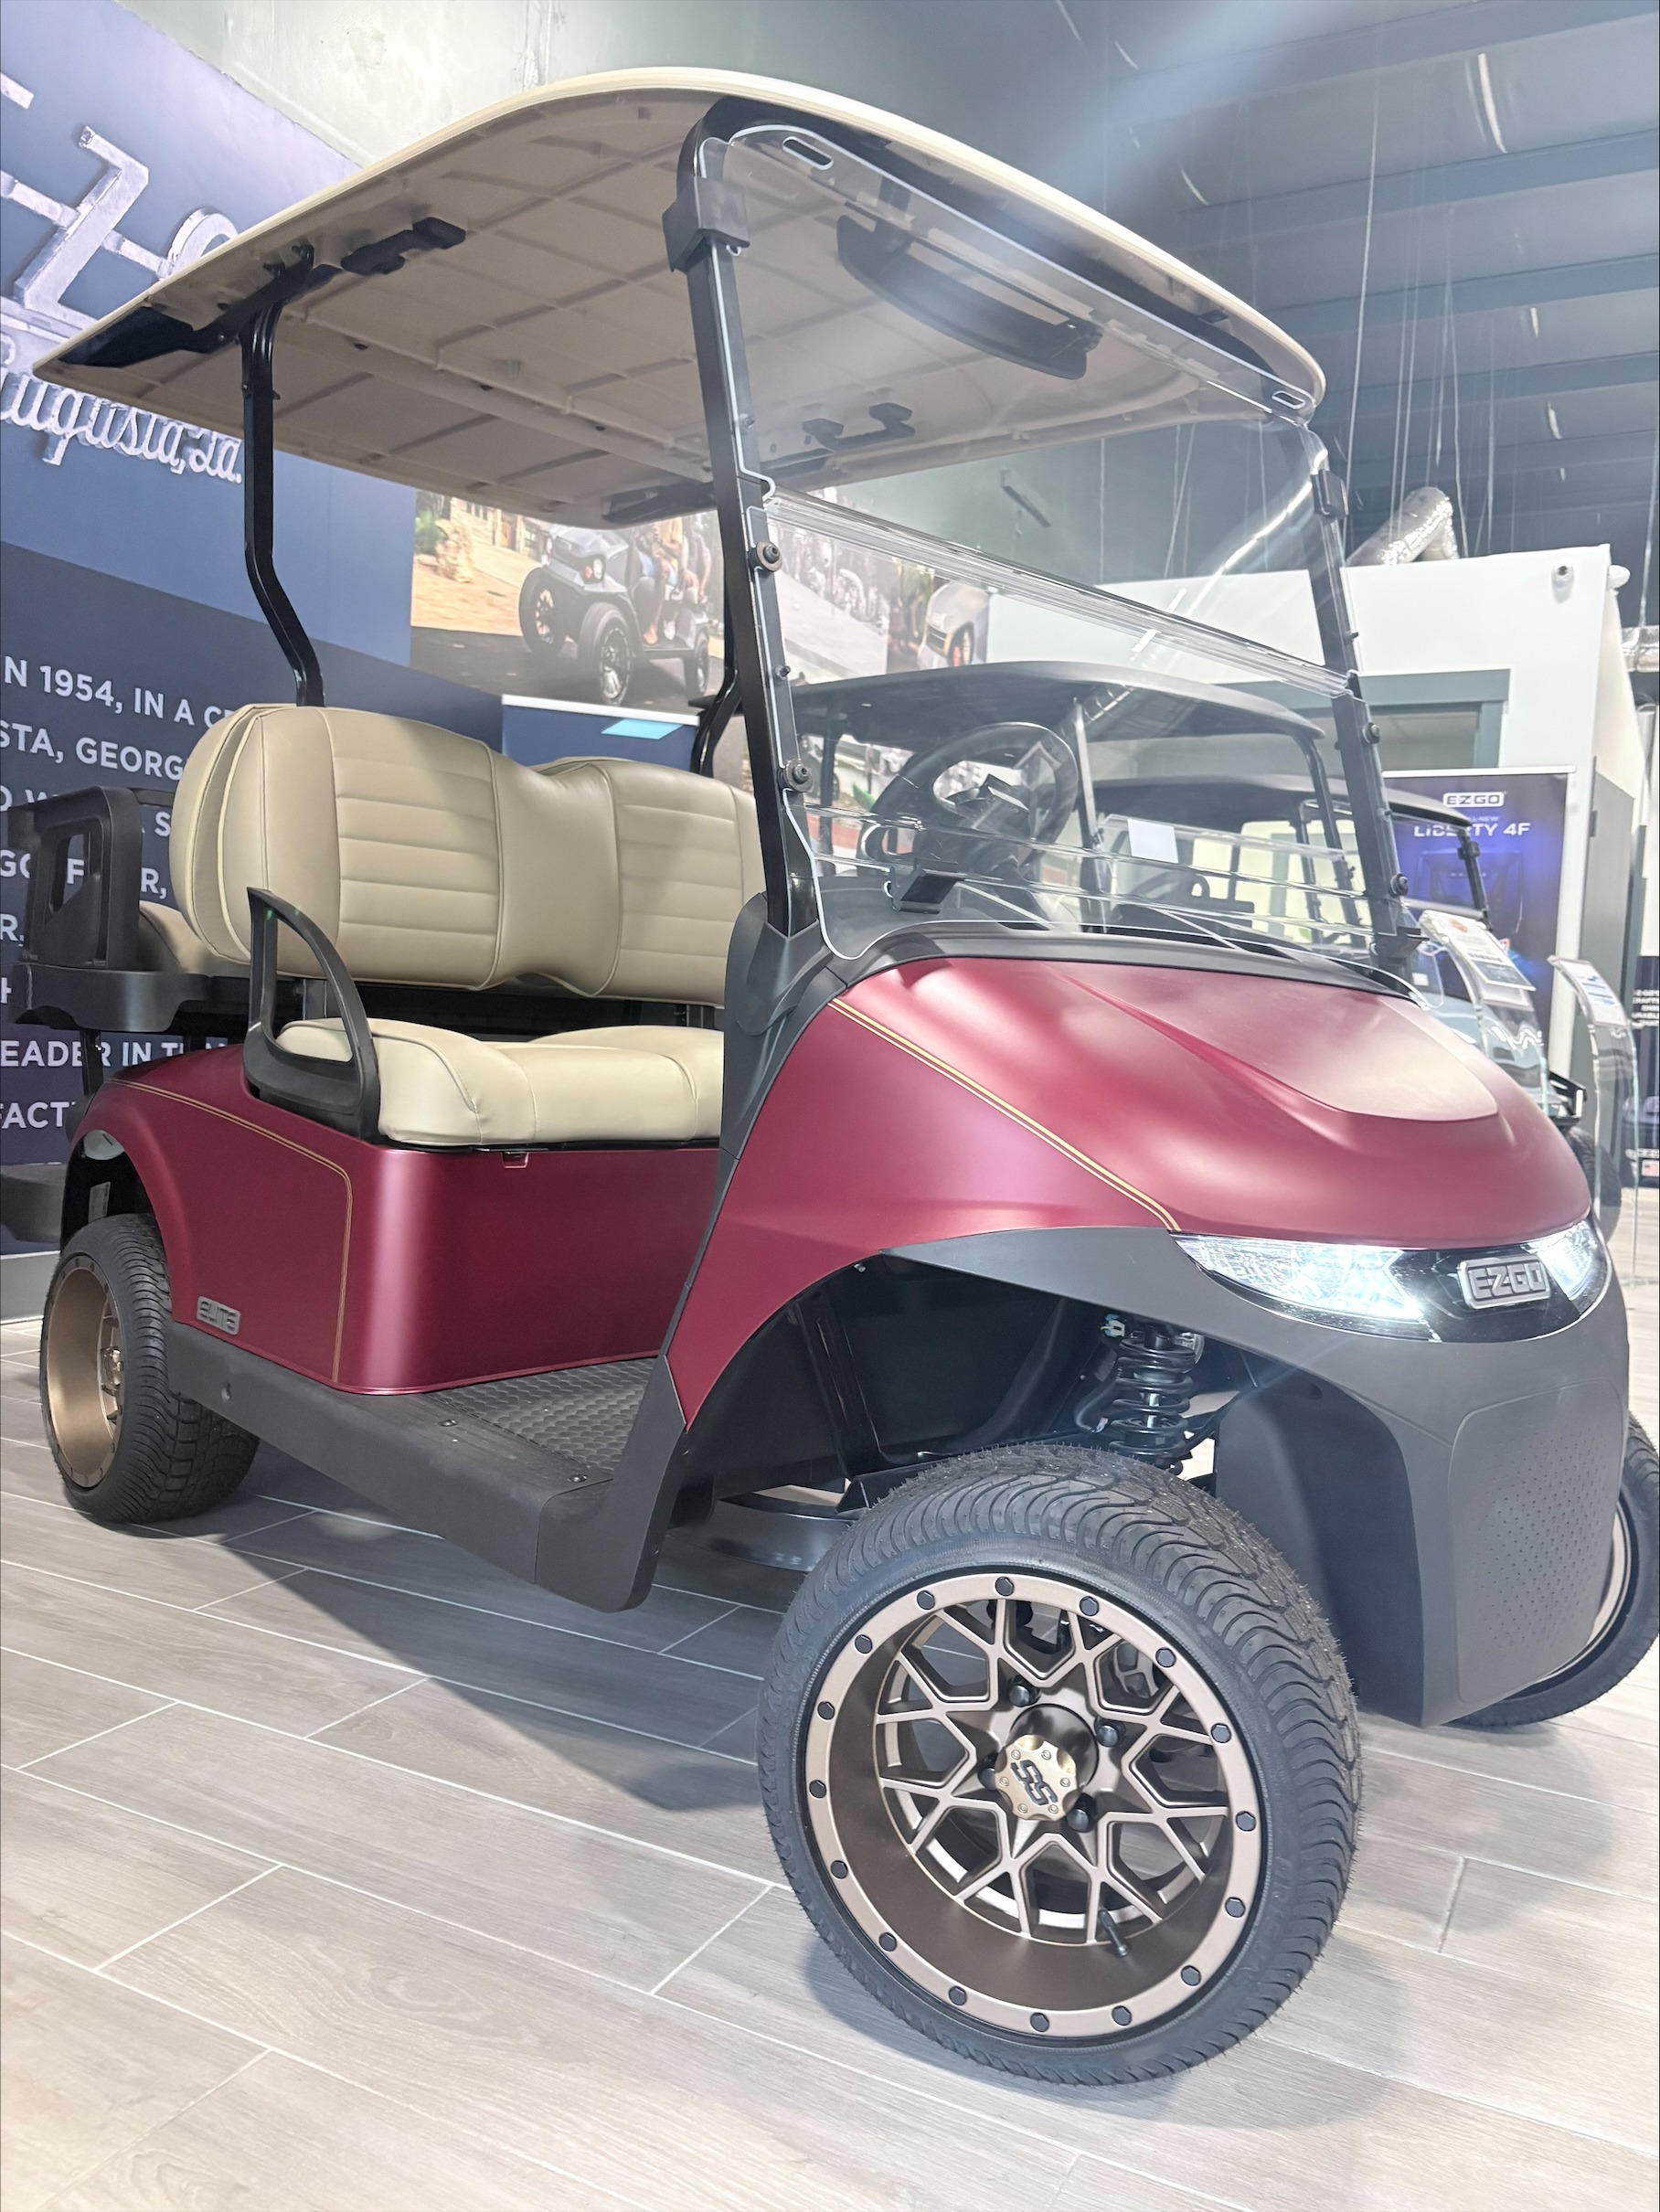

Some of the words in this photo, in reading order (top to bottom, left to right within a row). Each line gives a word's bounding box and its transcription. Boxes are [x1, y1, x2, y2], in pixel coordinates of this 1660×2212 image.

[39, 665, 122, 715] 1954,
[133, 687, 165, 719] IN
[174, 698, 195, 726] A
[75, 736, 188, 782] GEORG
[1445, 793, 1502, 805] EZGO
[1504, 823, 1532, 836] 4F
[122, 1042, 152, 1068] IN
[1467, 1260, 1547, 1301] EZGO
[199, 1300, 237, 1332] ELITE
